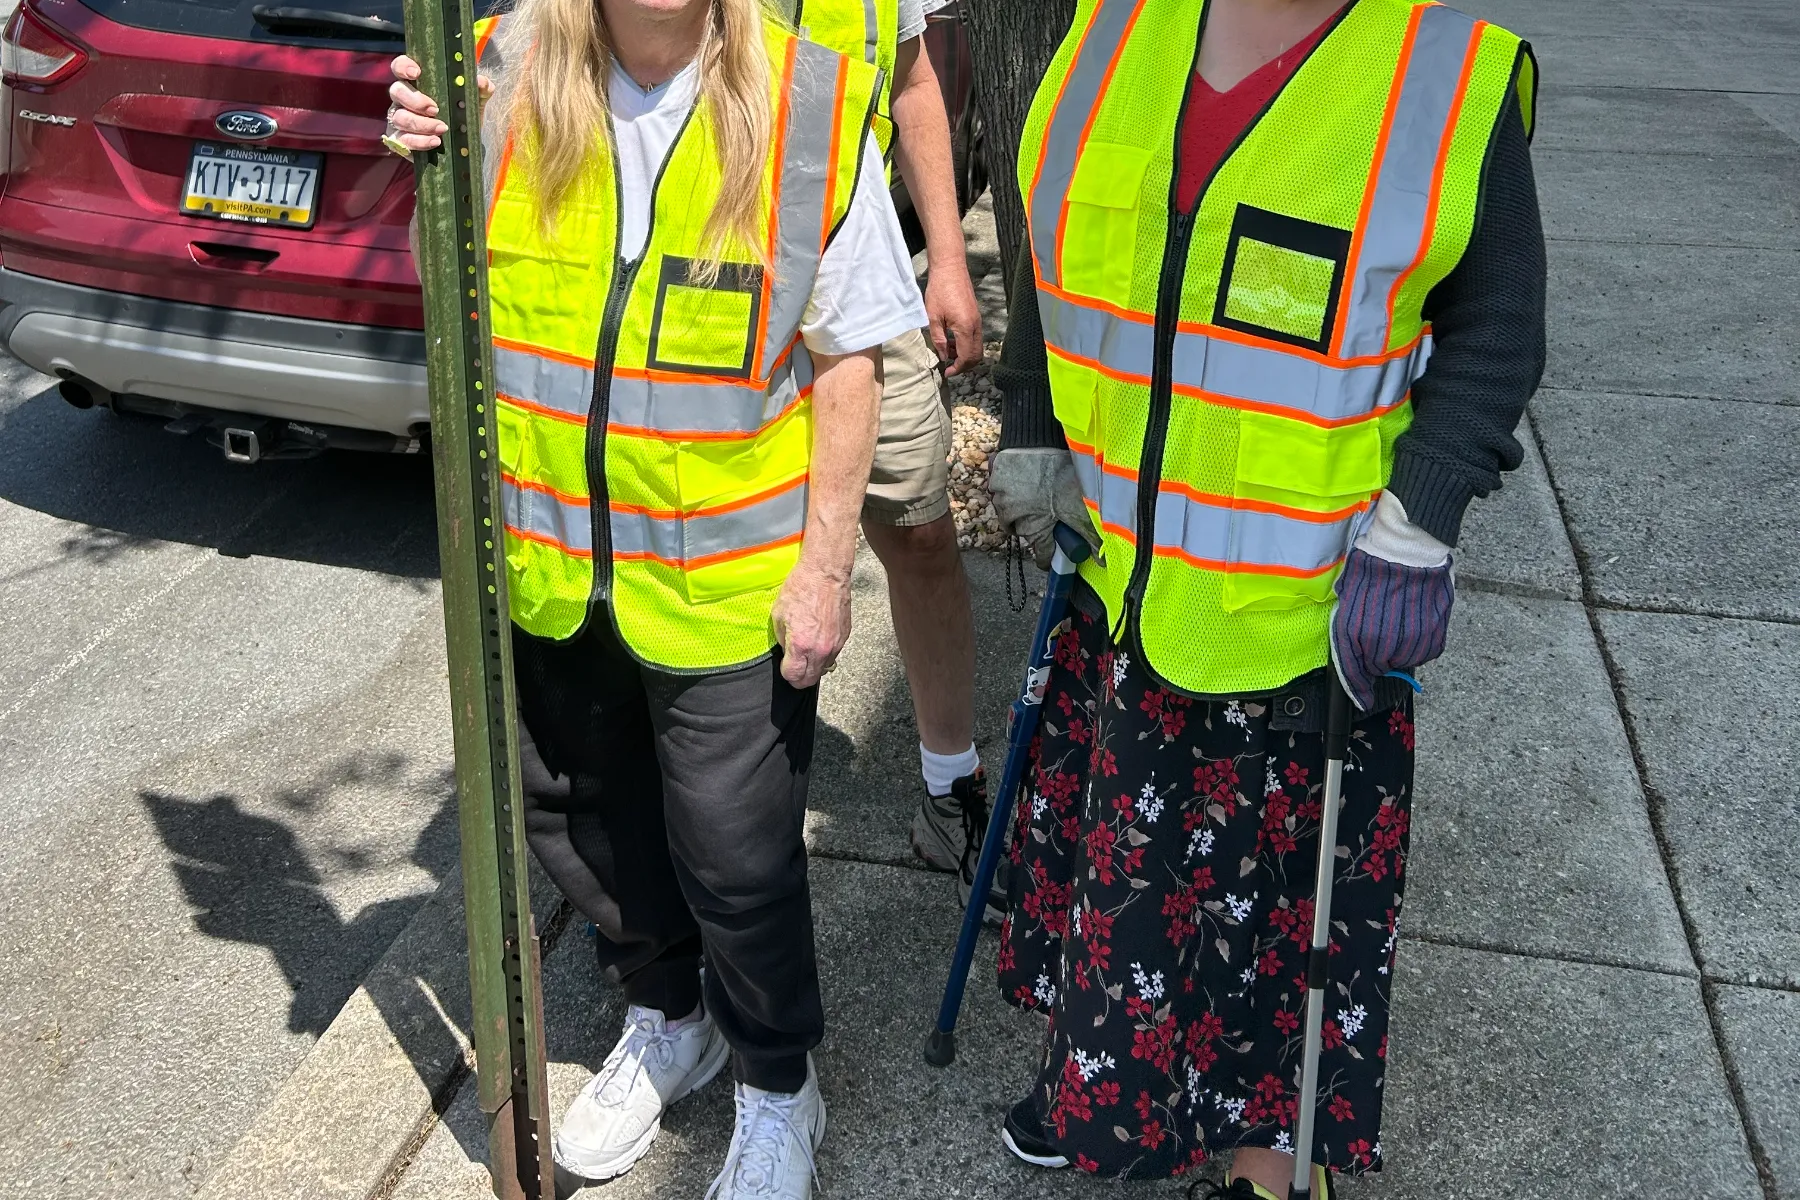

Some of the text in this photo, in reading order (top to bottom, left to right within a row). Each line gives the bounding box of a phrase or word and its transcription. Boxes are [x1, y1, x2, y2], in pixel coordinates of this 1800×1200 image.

[19, 109, 77, 126] ESCAPE
[226, 114, 262, 134] Ford
[225, 149, 289, 164] PENNSYLVANIA
[226, 202, 271, 215] visitPA.com
